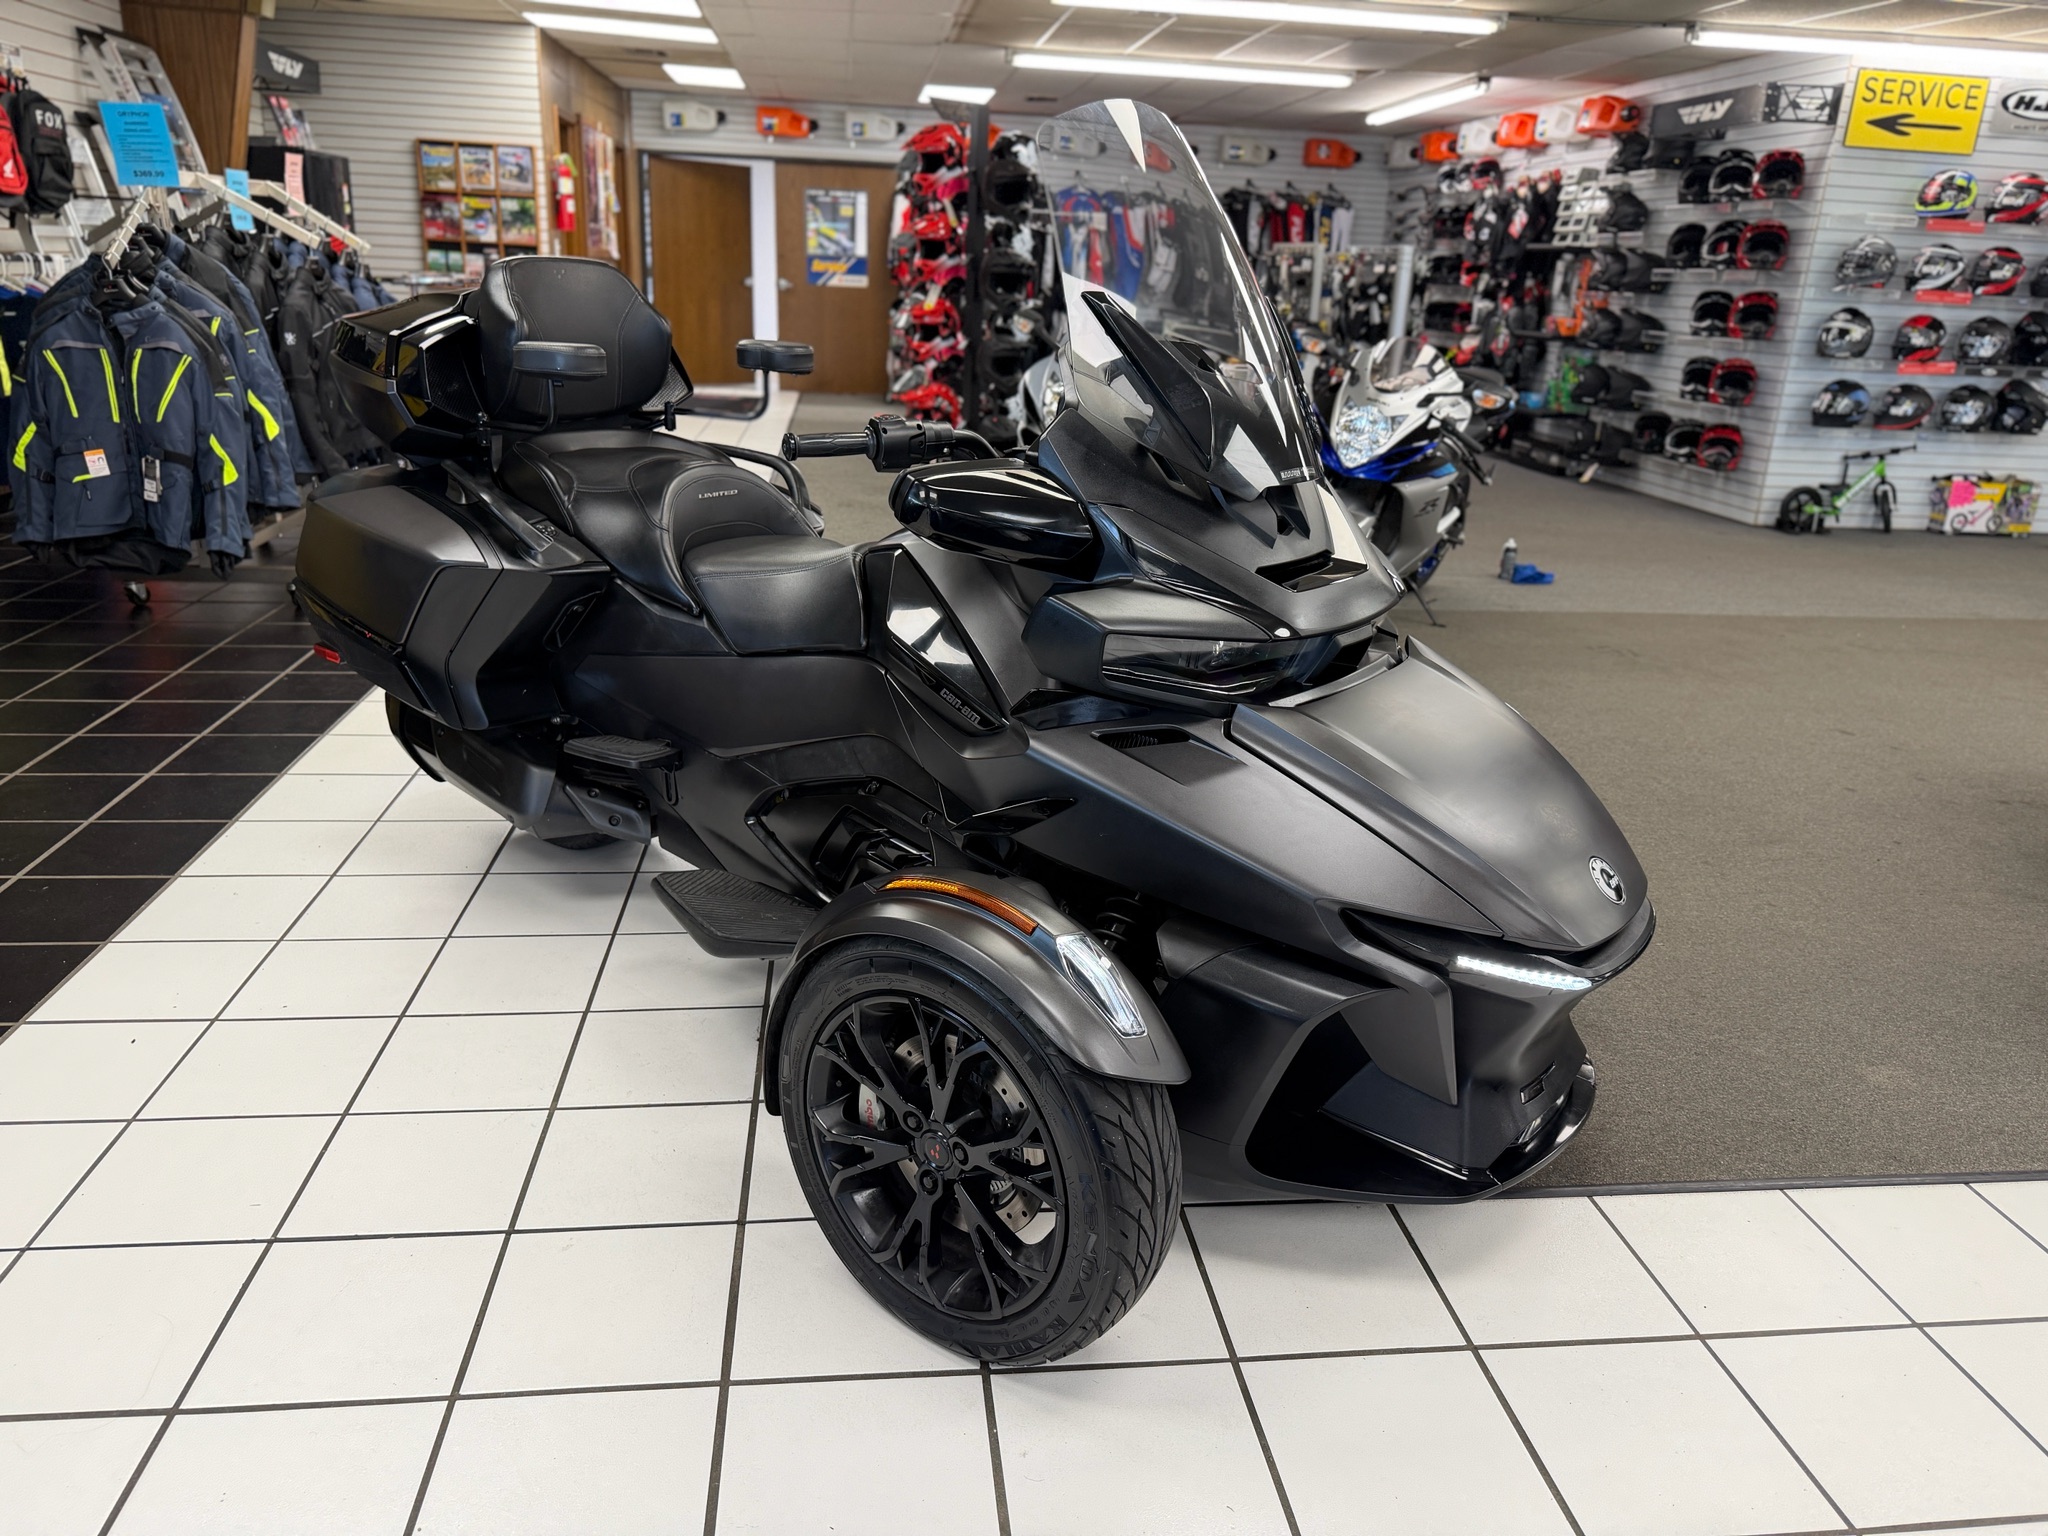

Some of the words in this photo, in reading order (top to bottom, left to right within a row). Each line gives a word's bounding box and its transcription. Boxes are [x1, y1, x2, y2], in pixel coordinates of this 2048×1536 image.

[1861, 76, 1982, 111] SERVICE
[35, 109, 63, 129] FOX
[1677, 98, 1734, 125] FLY
[698, 489, 738, 499] LIMITED
[1068, 1173, 1099, 1303] KENDA
